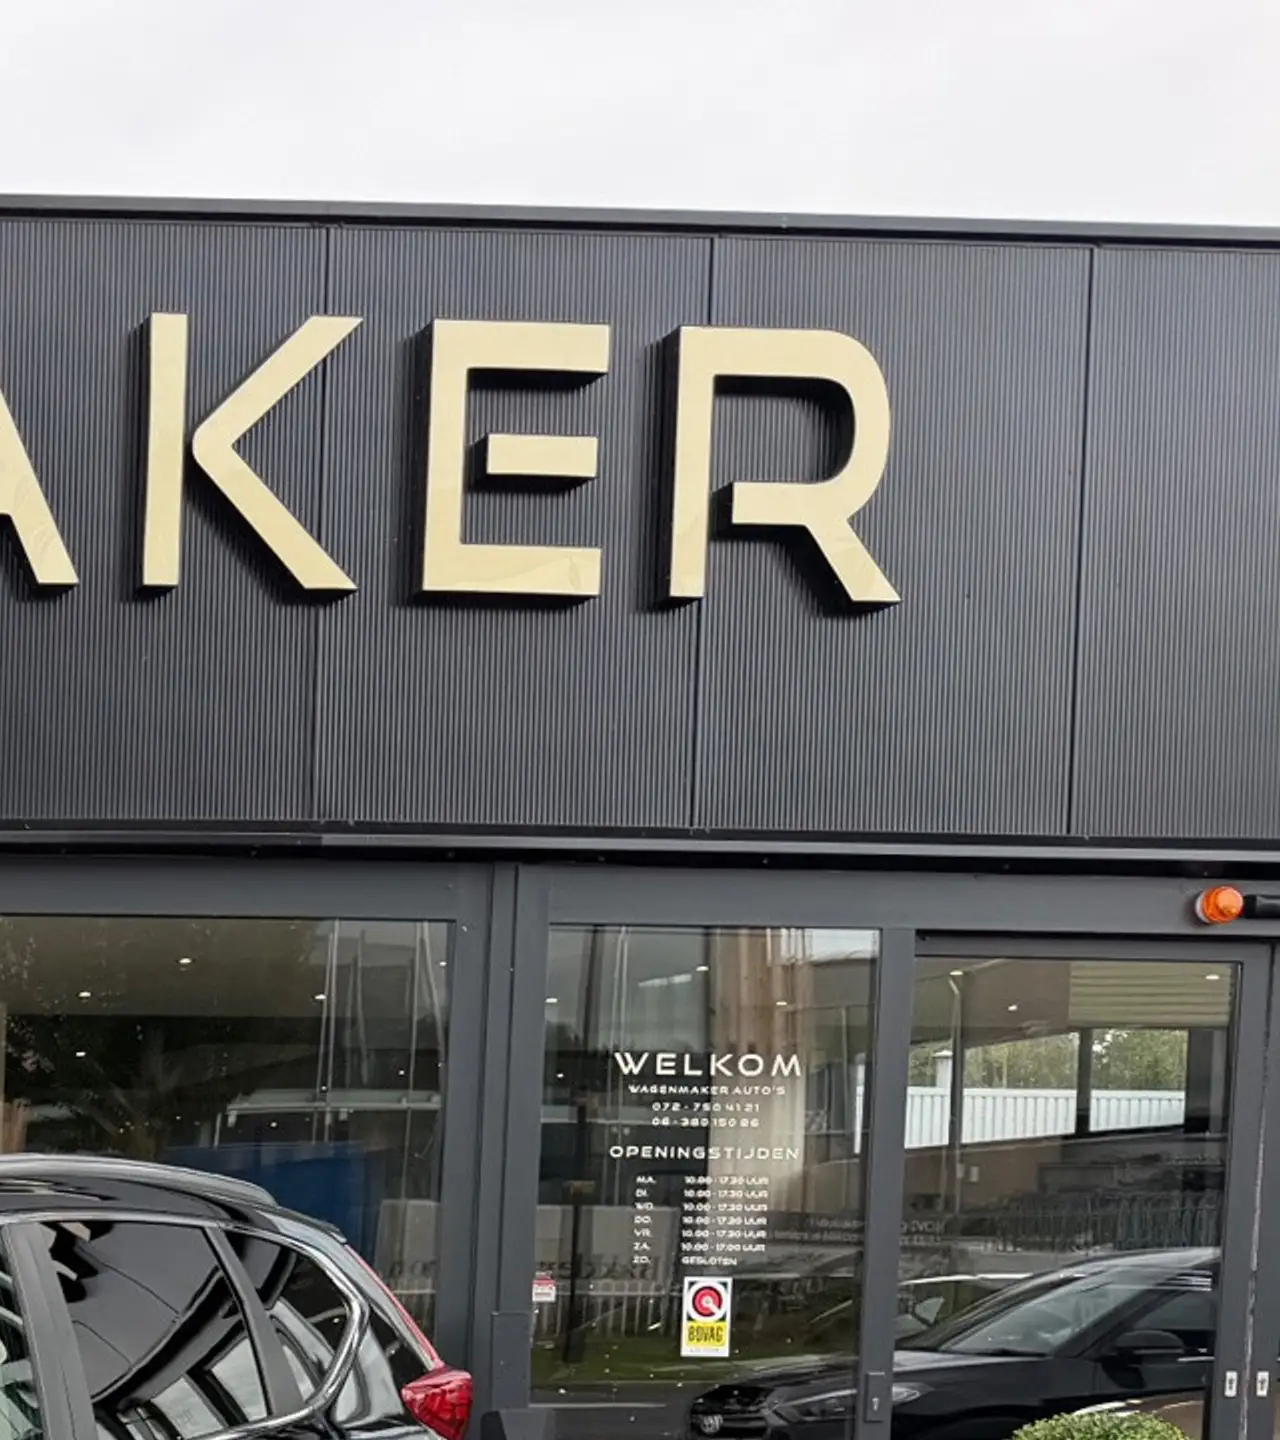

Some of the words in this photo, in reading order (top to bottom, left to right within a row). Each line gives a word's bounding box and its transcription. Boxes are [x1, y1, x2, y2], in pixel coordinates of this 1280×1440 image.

[614, 1052, 801, 1077] WELKOM
[628, 1084, 729, 1095] WAGENMAKER
[732, 1085, 786, 1096] AUTO'S
[609, 1145, 799, 1160] OPENINGSTIJDEN
[688, 1325, 724, 1342] BOVAG
